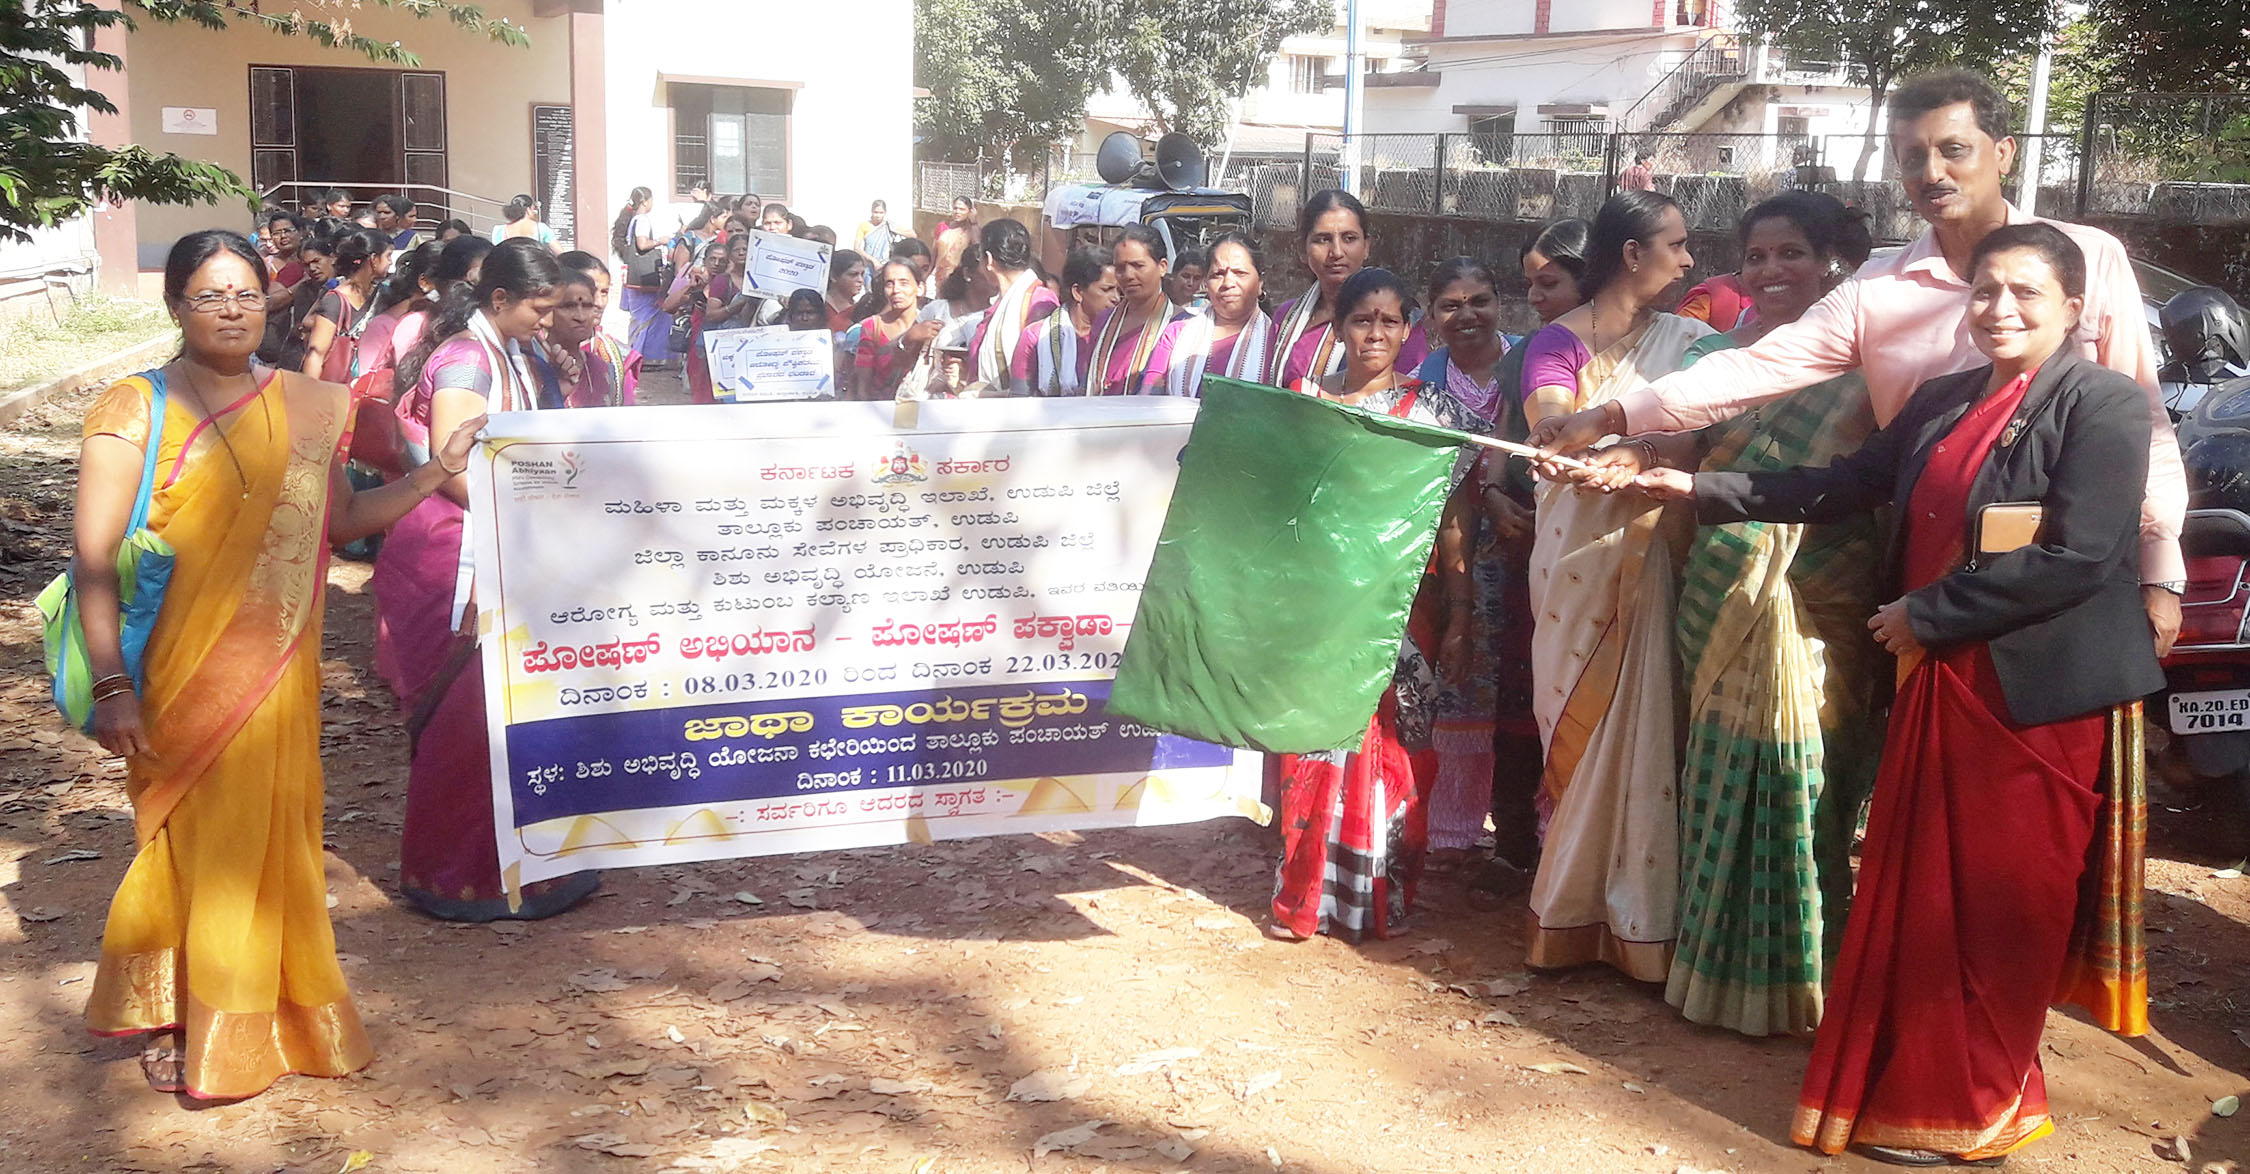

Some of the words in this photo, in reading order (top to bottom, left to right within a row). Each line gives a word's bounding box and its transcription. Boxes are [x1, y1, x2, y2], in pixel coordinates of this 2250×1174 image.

[760, 462, 855, 481] ಕರ್ನಾಟಕ
[936, 455, 1010, 475] ಸರ್ಕಾರ
[604, 500, 682, 515] ಮಹಿಳಾ
[696, 500, 750, 517] ಮತ್ತು
[760, 497, 818, 516] ಮಕ್ಕಳ
[830, 490, 911, 512] ಅಭಿವೃದ್ಧಿ
[1007, 485, 1074, 499] ಉಡುಪಿ
[1086, 481, 1121, 502] ಜಿಲ್ಲೆ
[718, 519, 803, 540] ತಾಲ್ಲೂಕು
[951, 512, 1019, 526] ಉಡುಪಿ
[634, 549, 685, 569] ಜಿಲ್ಲಾ
[697, 545, 780, 563] ಕಾನೂನು
[792, 540, 868, 558] ಸೇವೆಗಳ
[981, 535, 1049, 549] ಉಡುಪಿ
[1060, 533, 1096, 551] ಜಿಲ್ಲೆ
[712, 571, 751, 586] ಶಿಶು
[764, 568, 844, 588] ಅಭಿವೃದ್ಧಿ
[957, 561, 1025, 575] ಉಡುಪಿ
[550, 605, 638, 626] ಆರೋಗ್ಯ
[650, 600, 703, 620] ಮತ್ತು
[713, 596, 794, 612] ಕುಟುಂಬ
[806, 593, 870, 614] ಕಲ್ಯಾಣ
[883, 588, 951, 603] ಇಲಾಖೆ
[1048, 582, 1086, 595] ಇವರ
[1094, 581, 1145, 591] ವತಿಯಿ
[523, 633, 660, 673] ಪೋಷಣ್
[679, 622, 816, 662] ಅಭಿಯಾನ
[872, 614, 997, 647] ಪೋಷಣ್
[560, 680, 649, 706] ದಿನಾಂಕ
[685, 667, 828, 695] 08.03.2020
[844, 663, 897, 683] ರಿಂದ
[911, 657, 992, 679] ದಿನಾಂಕ
[1006, 652, 1122, 673] 22.03.202
[683, 708, 815, 742] ಜಾಥಾ
[841, 688, 1088, 728] ಕಾರ್ಯಕ್ರಮ
[2186, 713, 2243, 729] 7014
[575, 758, 612, 779] ಶಿಶು
[623, 751, 701, 779] ಅಭಿವೃದ್ಧಿ
[708, 745, 799, 767] ಯೋಜನಾ
[926, 732, 999, 753] ತಾಲ್ಲೂಕು
[1009, 723, 1108, 744] ಪಂಚಾಯತ್
[796, 767, 862, 790] ದಿನಾಂಕ
[887, 759, 988, 783] 11.03.2020
[756, 799, 847, 821] ಸರ್ವರಿಗೂ
[860, 793, 924, 811] ಆದರದ
[935, 787, 985, 816] ಸ್ವಾಗತ
